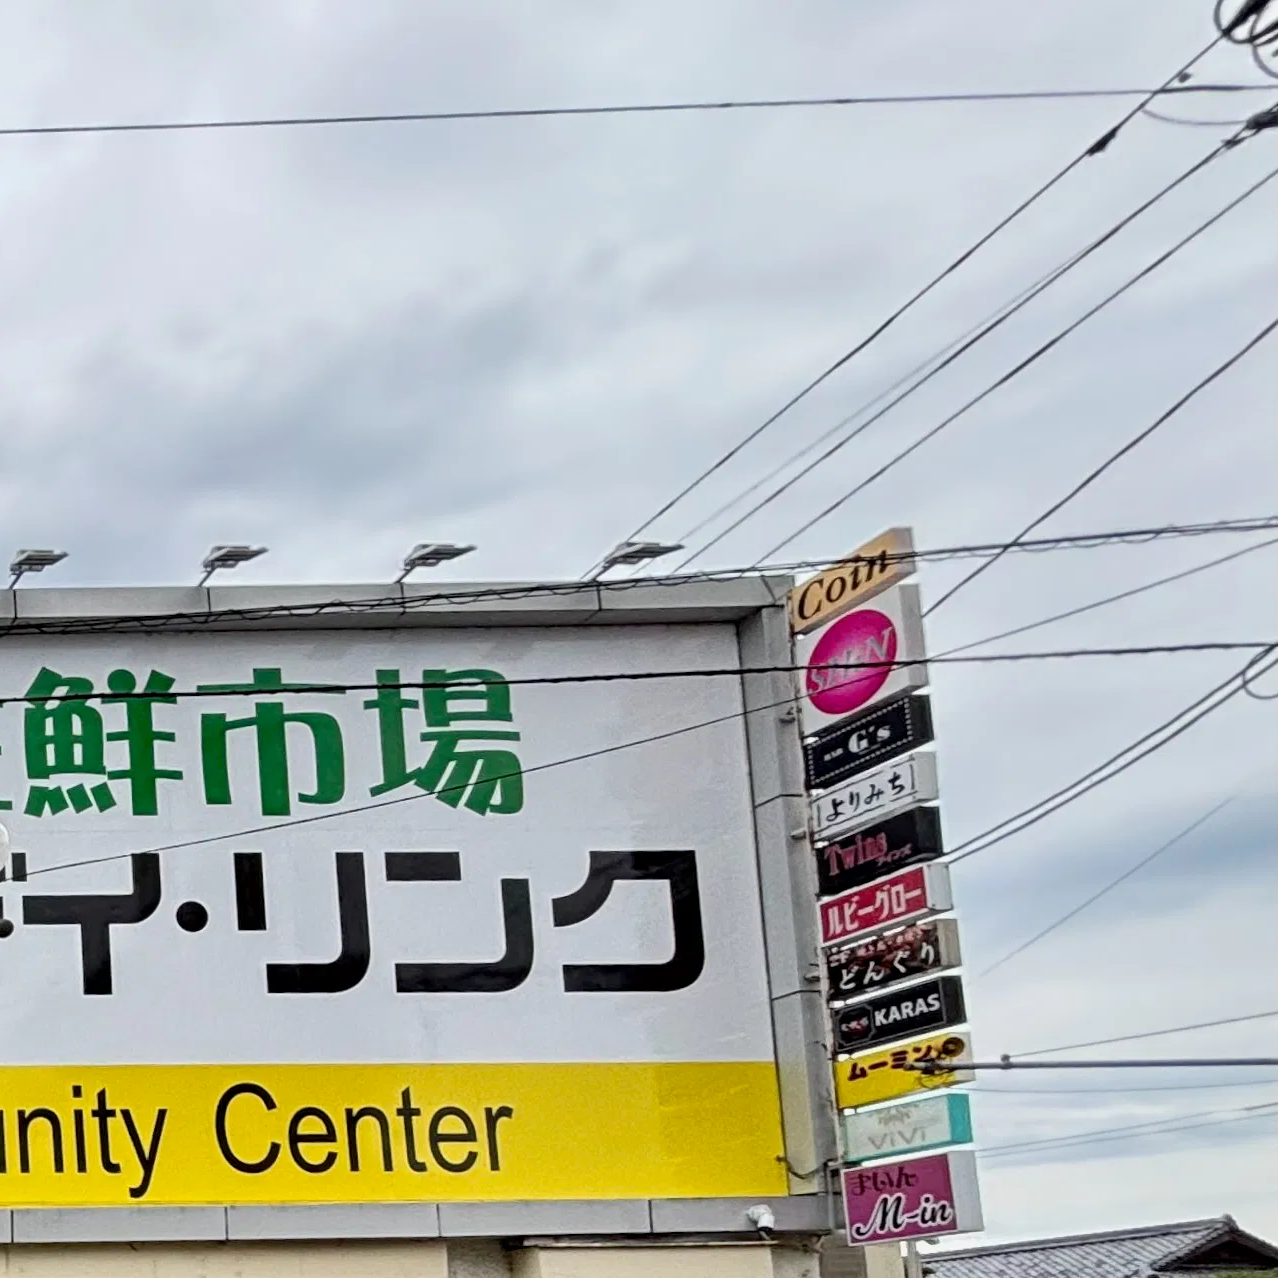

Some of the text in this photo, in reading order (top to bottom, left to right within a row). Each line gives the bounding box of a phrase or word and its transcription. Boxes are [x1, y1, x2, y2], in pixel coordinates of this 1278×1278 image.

[825, 771, 905, 822] よりみち
[826, 882, 923, 939] ルビーグロー
[838, 940, 936, 991] どんぐり
[873, 992, 941, 1028] KARAS
[214, 1082, 514, 1175] Center
[852, 1193, 953, 1238] M-in
